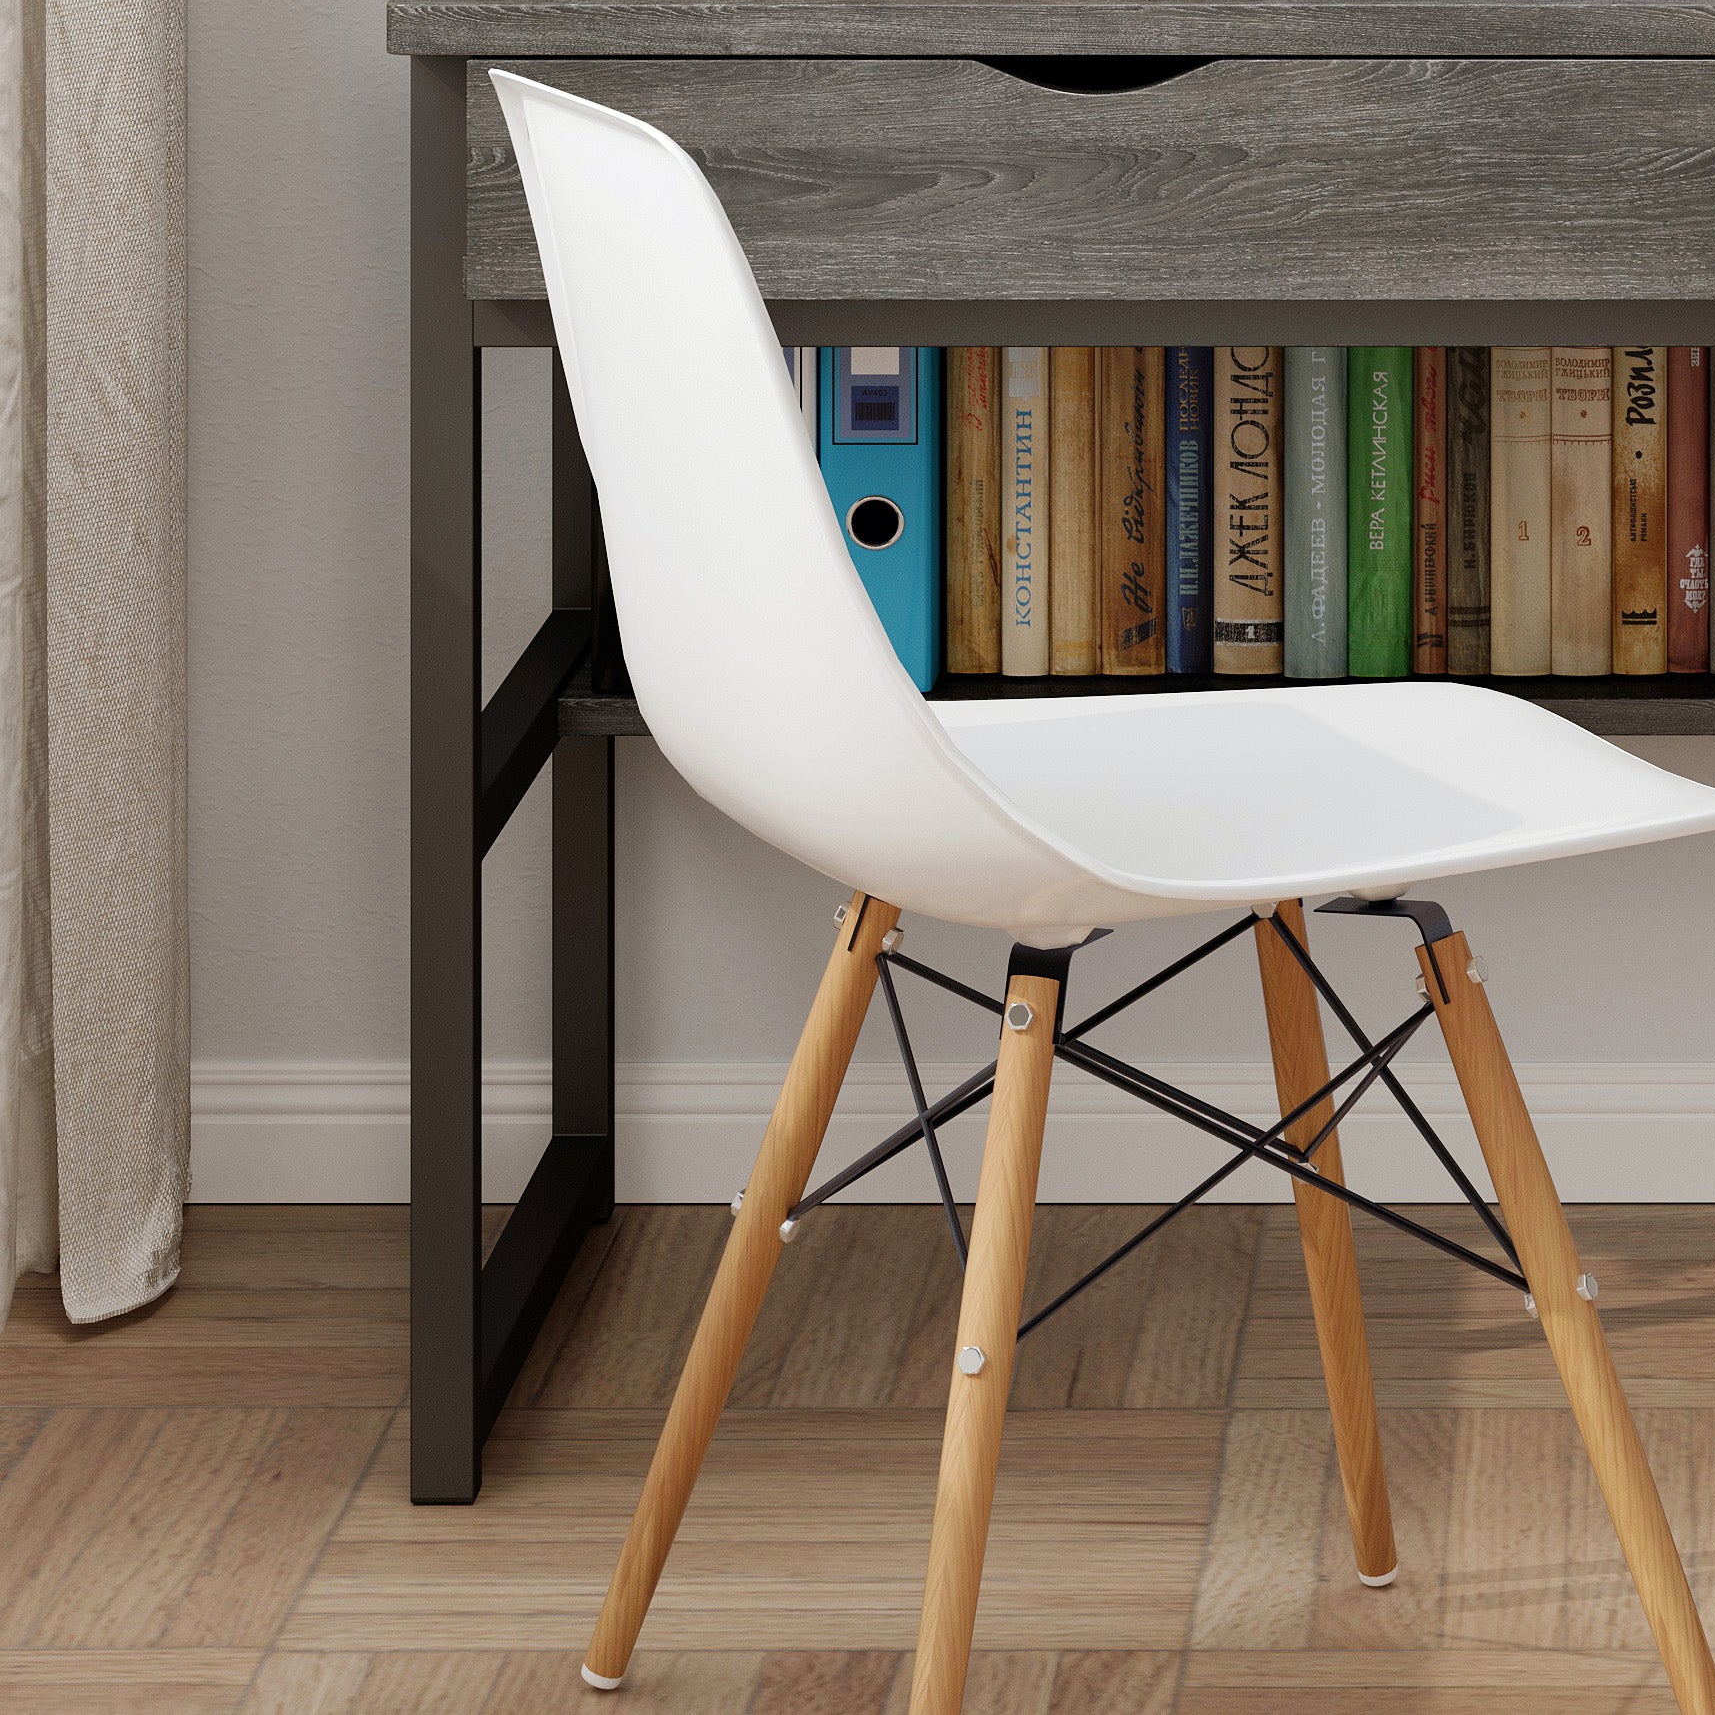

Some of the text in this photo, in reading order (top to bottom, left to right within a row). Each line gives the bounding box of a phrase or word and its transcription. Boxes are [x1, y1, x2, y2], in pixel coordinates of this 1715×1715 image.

[1554, 357, 1611, 369] ВОЛОДИМИР
[1189, 368, 1201, 431] НОВИК
[1497, 388, 1549, 403] ТВОРИ
[1555, 387, 1611, 402] ТВОРИ
[1311, 373, 1327, 496] МОЛОДАЯ
[1369, 370, 1389, 551] ВЕРА КЕТЛИНСКАЯ
[1015, 409, 1032, 628] КОНСТАНТИН
[1517, 519, 1530, 541] 1
[1575, 525, 1592, 547] 2
[1229, 492, 1274, 597] ДЖЕК
